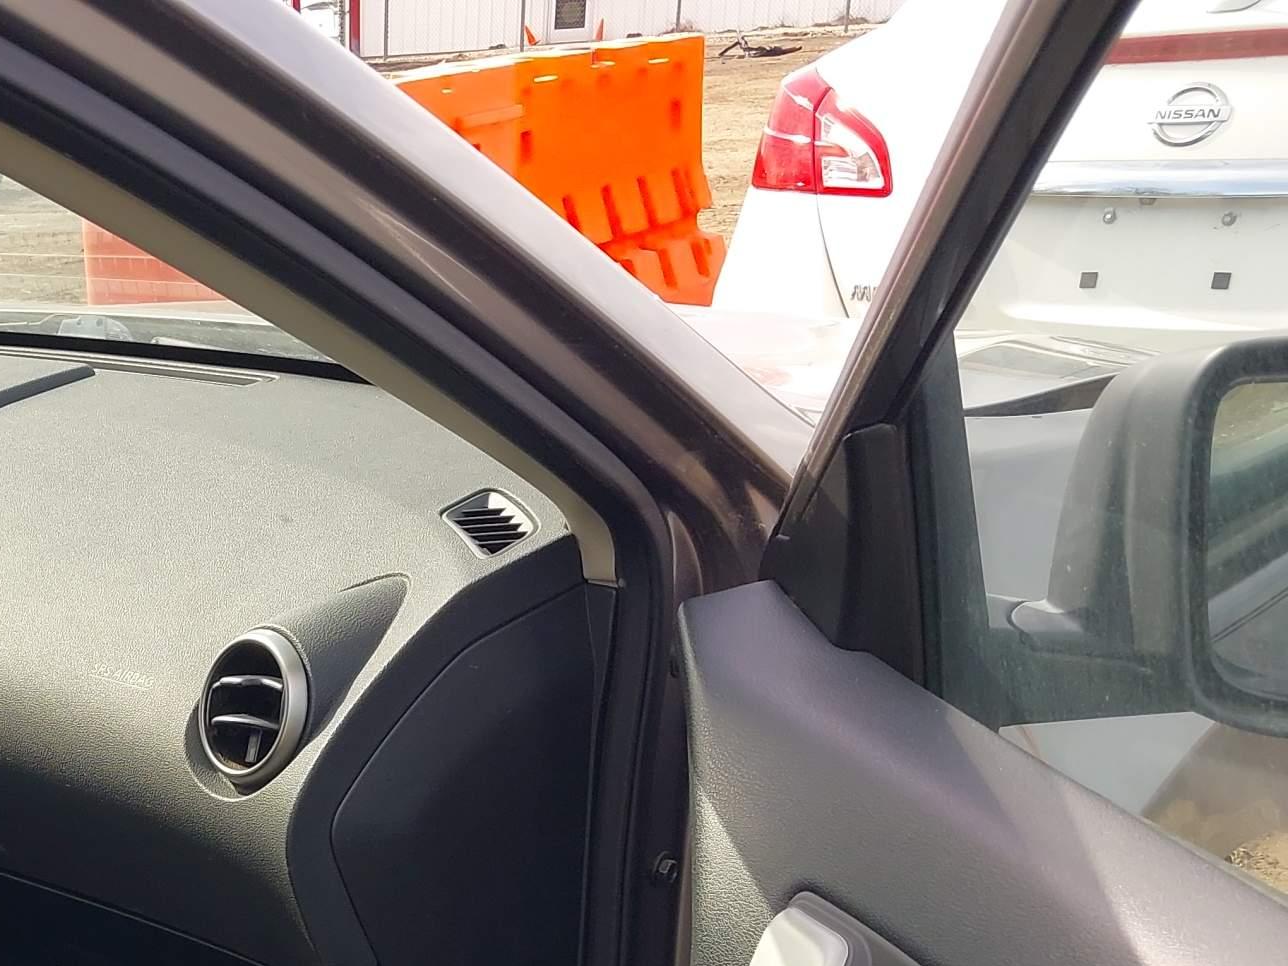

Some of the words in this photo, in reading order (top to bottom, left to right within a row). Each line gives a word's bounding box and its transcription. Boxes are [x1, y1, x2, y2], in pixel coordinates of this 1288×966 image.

[1155, 108, 1221, 120] NISSAN
[91, 664, 113, 676] SRS
[114, 669, 154, 686] AIRBAG
